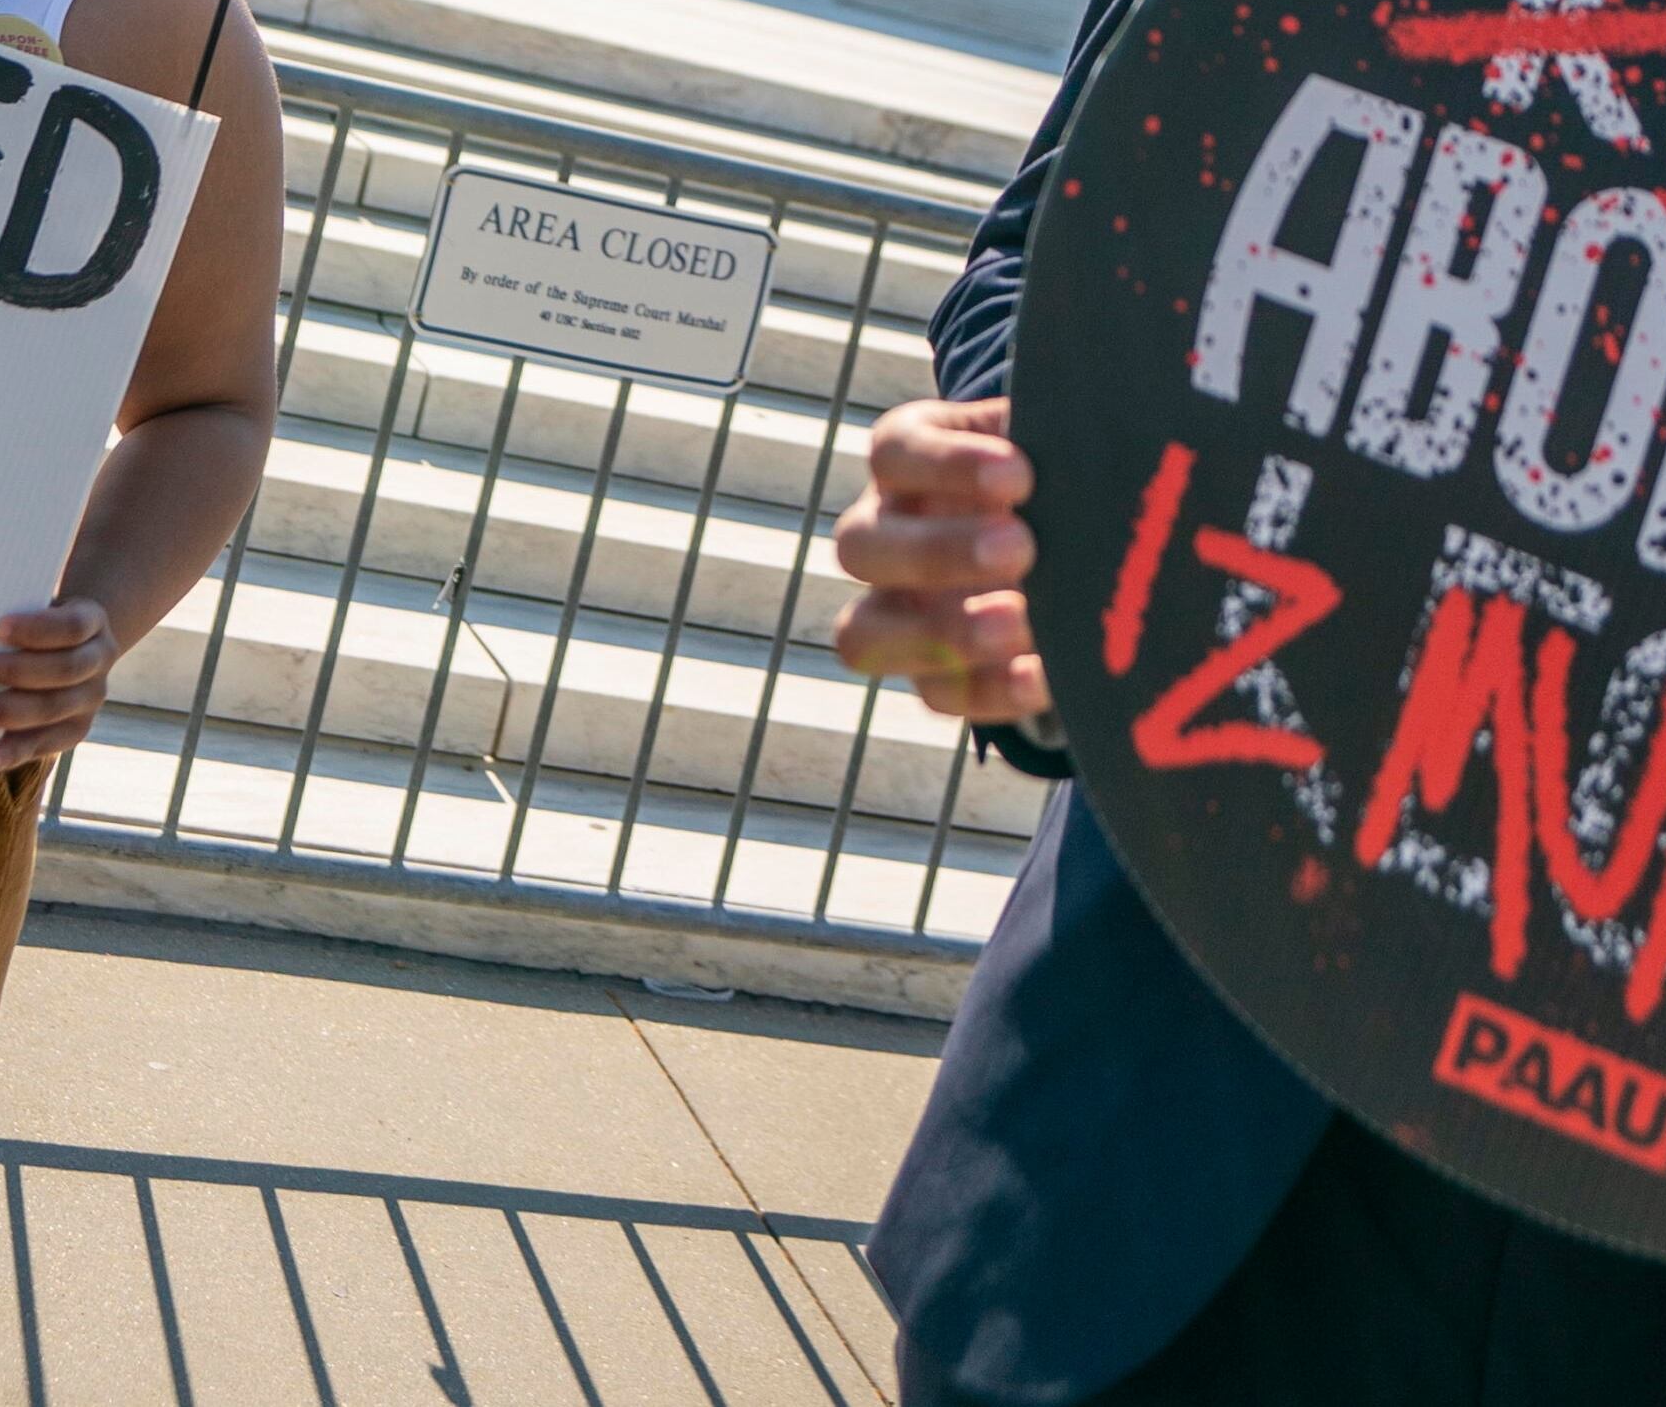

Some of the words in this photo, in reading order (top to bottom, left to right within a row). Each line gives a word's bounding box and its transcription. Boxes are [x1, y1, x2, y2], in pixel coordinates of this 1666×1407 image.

[478, 203, 581, 252] AREA
[601, 228, 737, 282] CLOSED
[461, 266, 478, 284] By
[483, 274, 520, 291] order
[525, 281, 542, 294] of
[546, 285, 567, 300] the
[572, 290, 628, 313] Supreme
[635, 303, 670, 322] Court
[676, 311, 727, 332] Marshal
[1102, 442, 1340, 768] IZ
